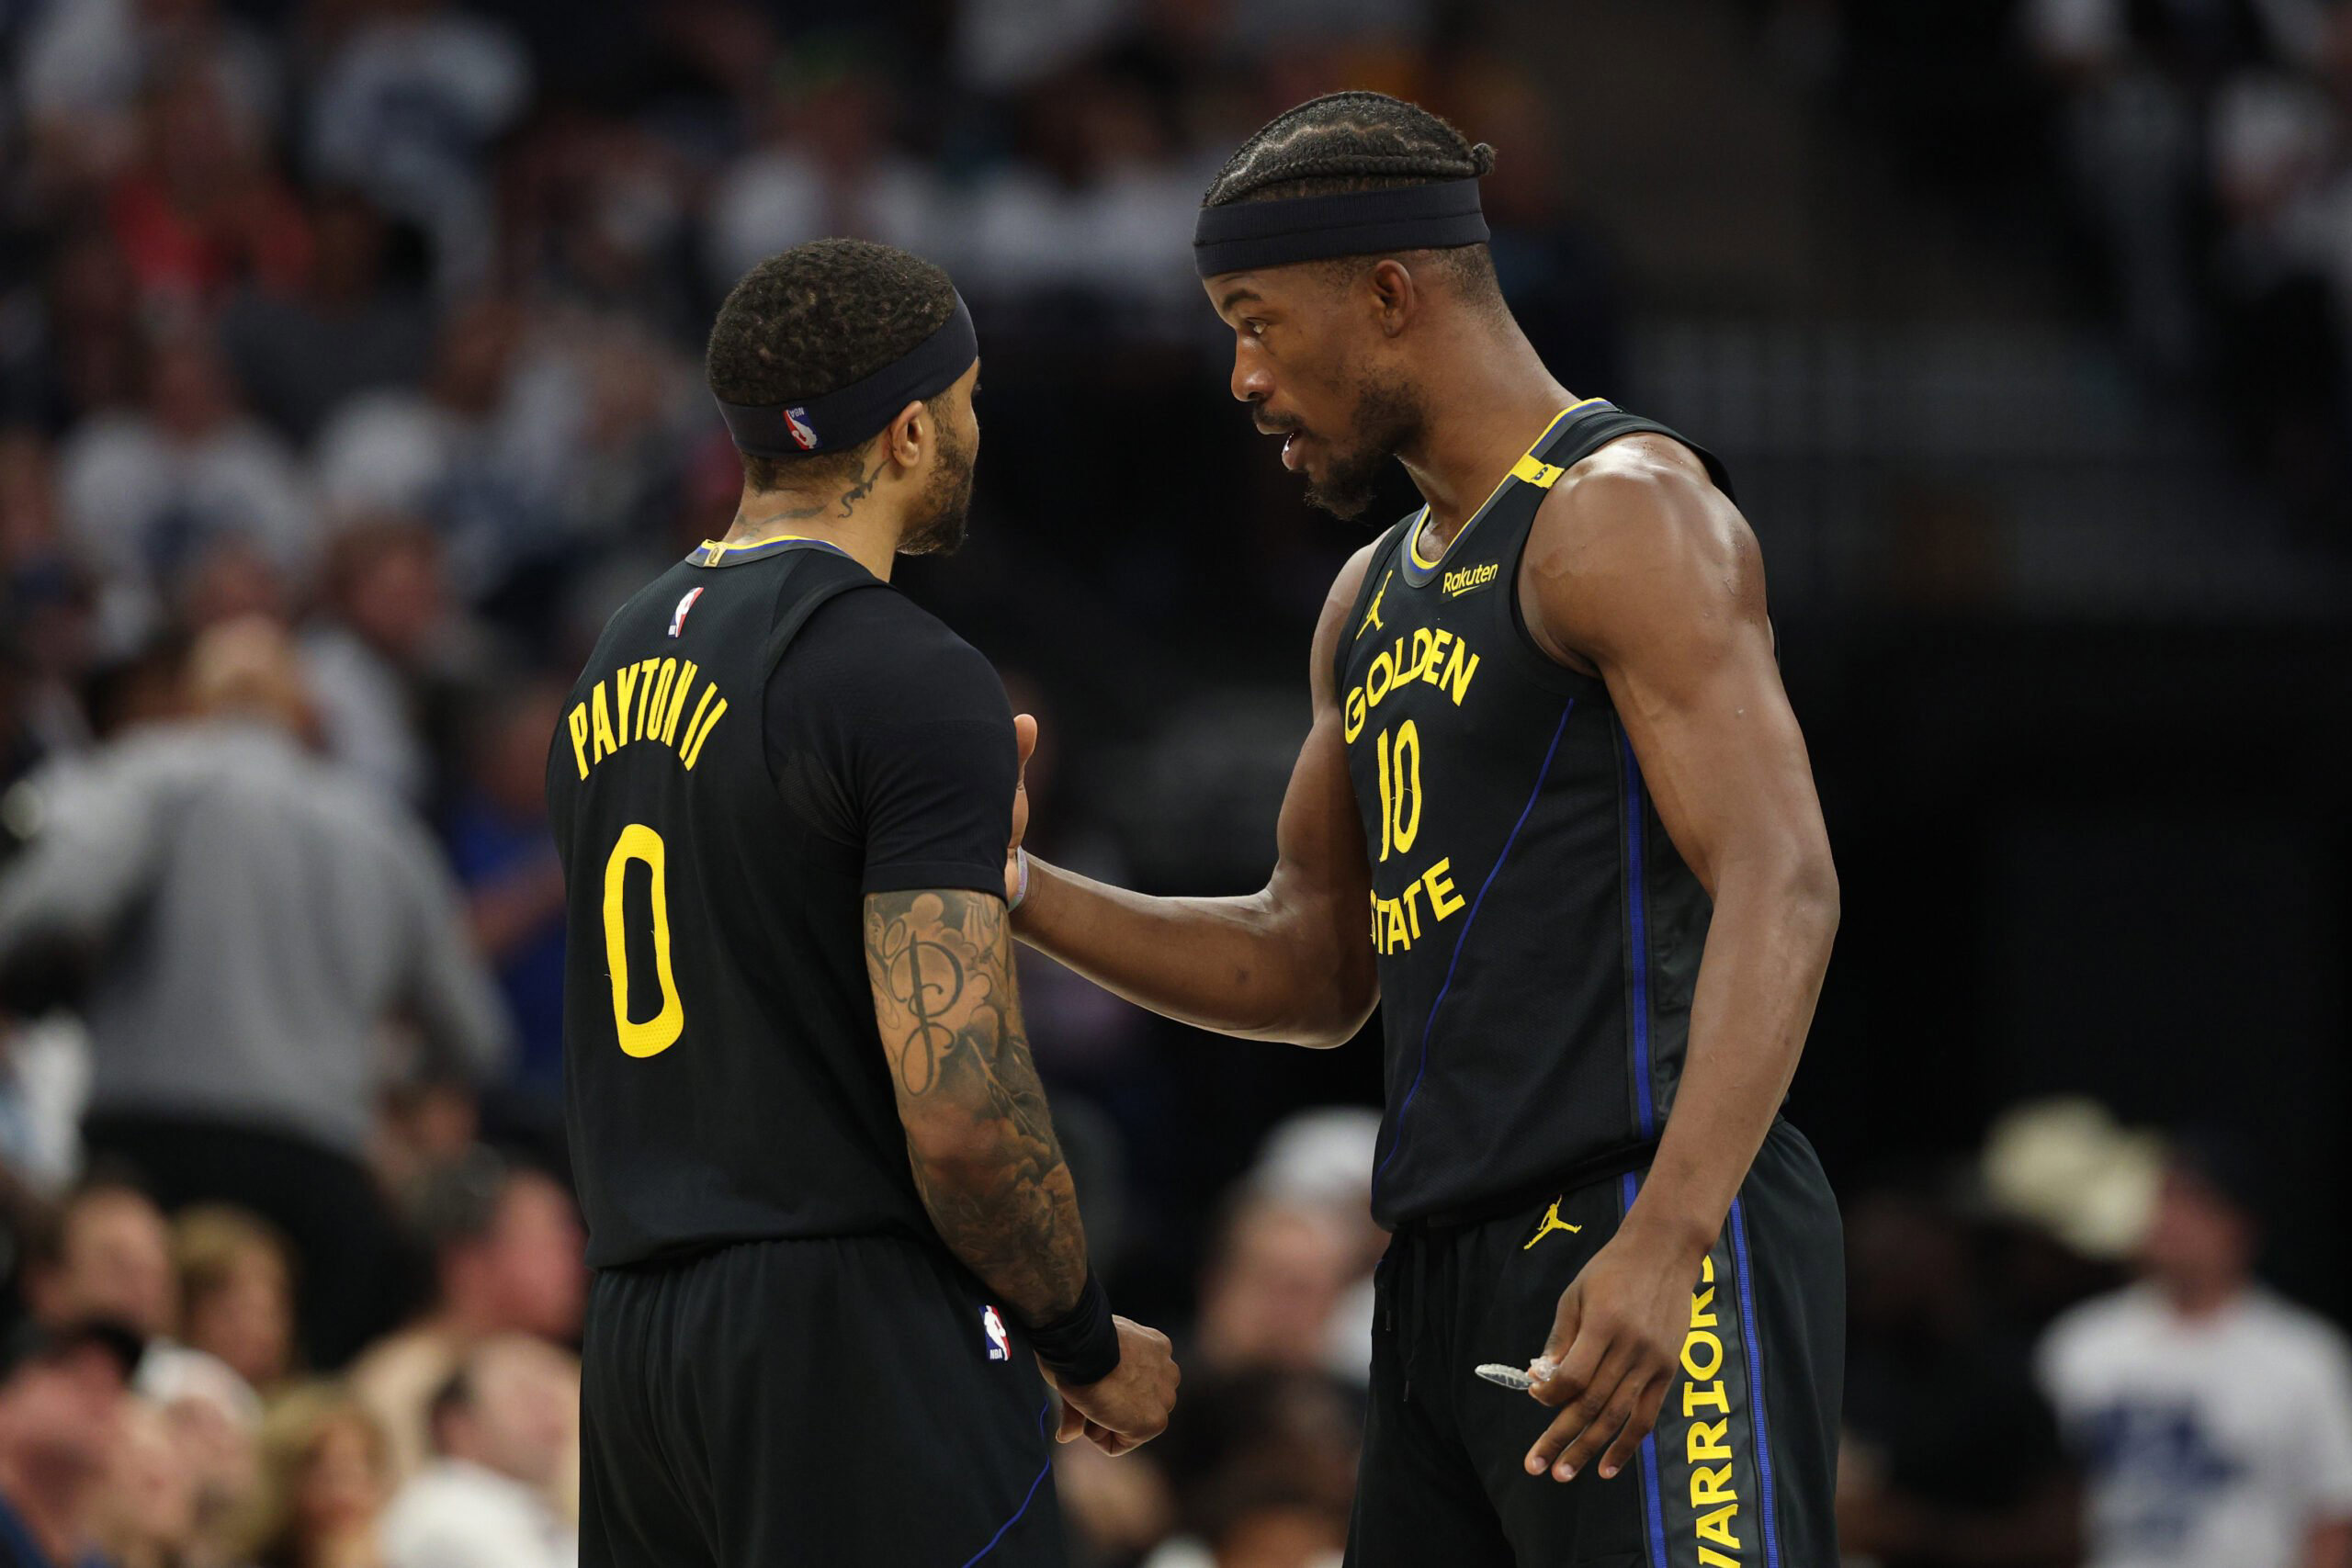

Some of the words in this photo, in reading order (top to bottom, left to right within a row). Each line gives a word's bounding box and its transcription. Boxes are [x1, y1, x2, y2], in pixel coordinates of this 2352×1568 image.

[790, 407, 804, 418] NBA
[1442, 563, 1498, 594] Rakuten
[568, 657, 698, 781] PAYTON
[679, 682, 728, 771] II
[1344, 627, 1480, 744] GOLDEN
[1377, 719, 1422, 863] 10
[603, 823, 684, 1058] 0
[990, 1348, 1002, 1359] NBA
[1679, 1255, 1741, 1568] ARRIOR
